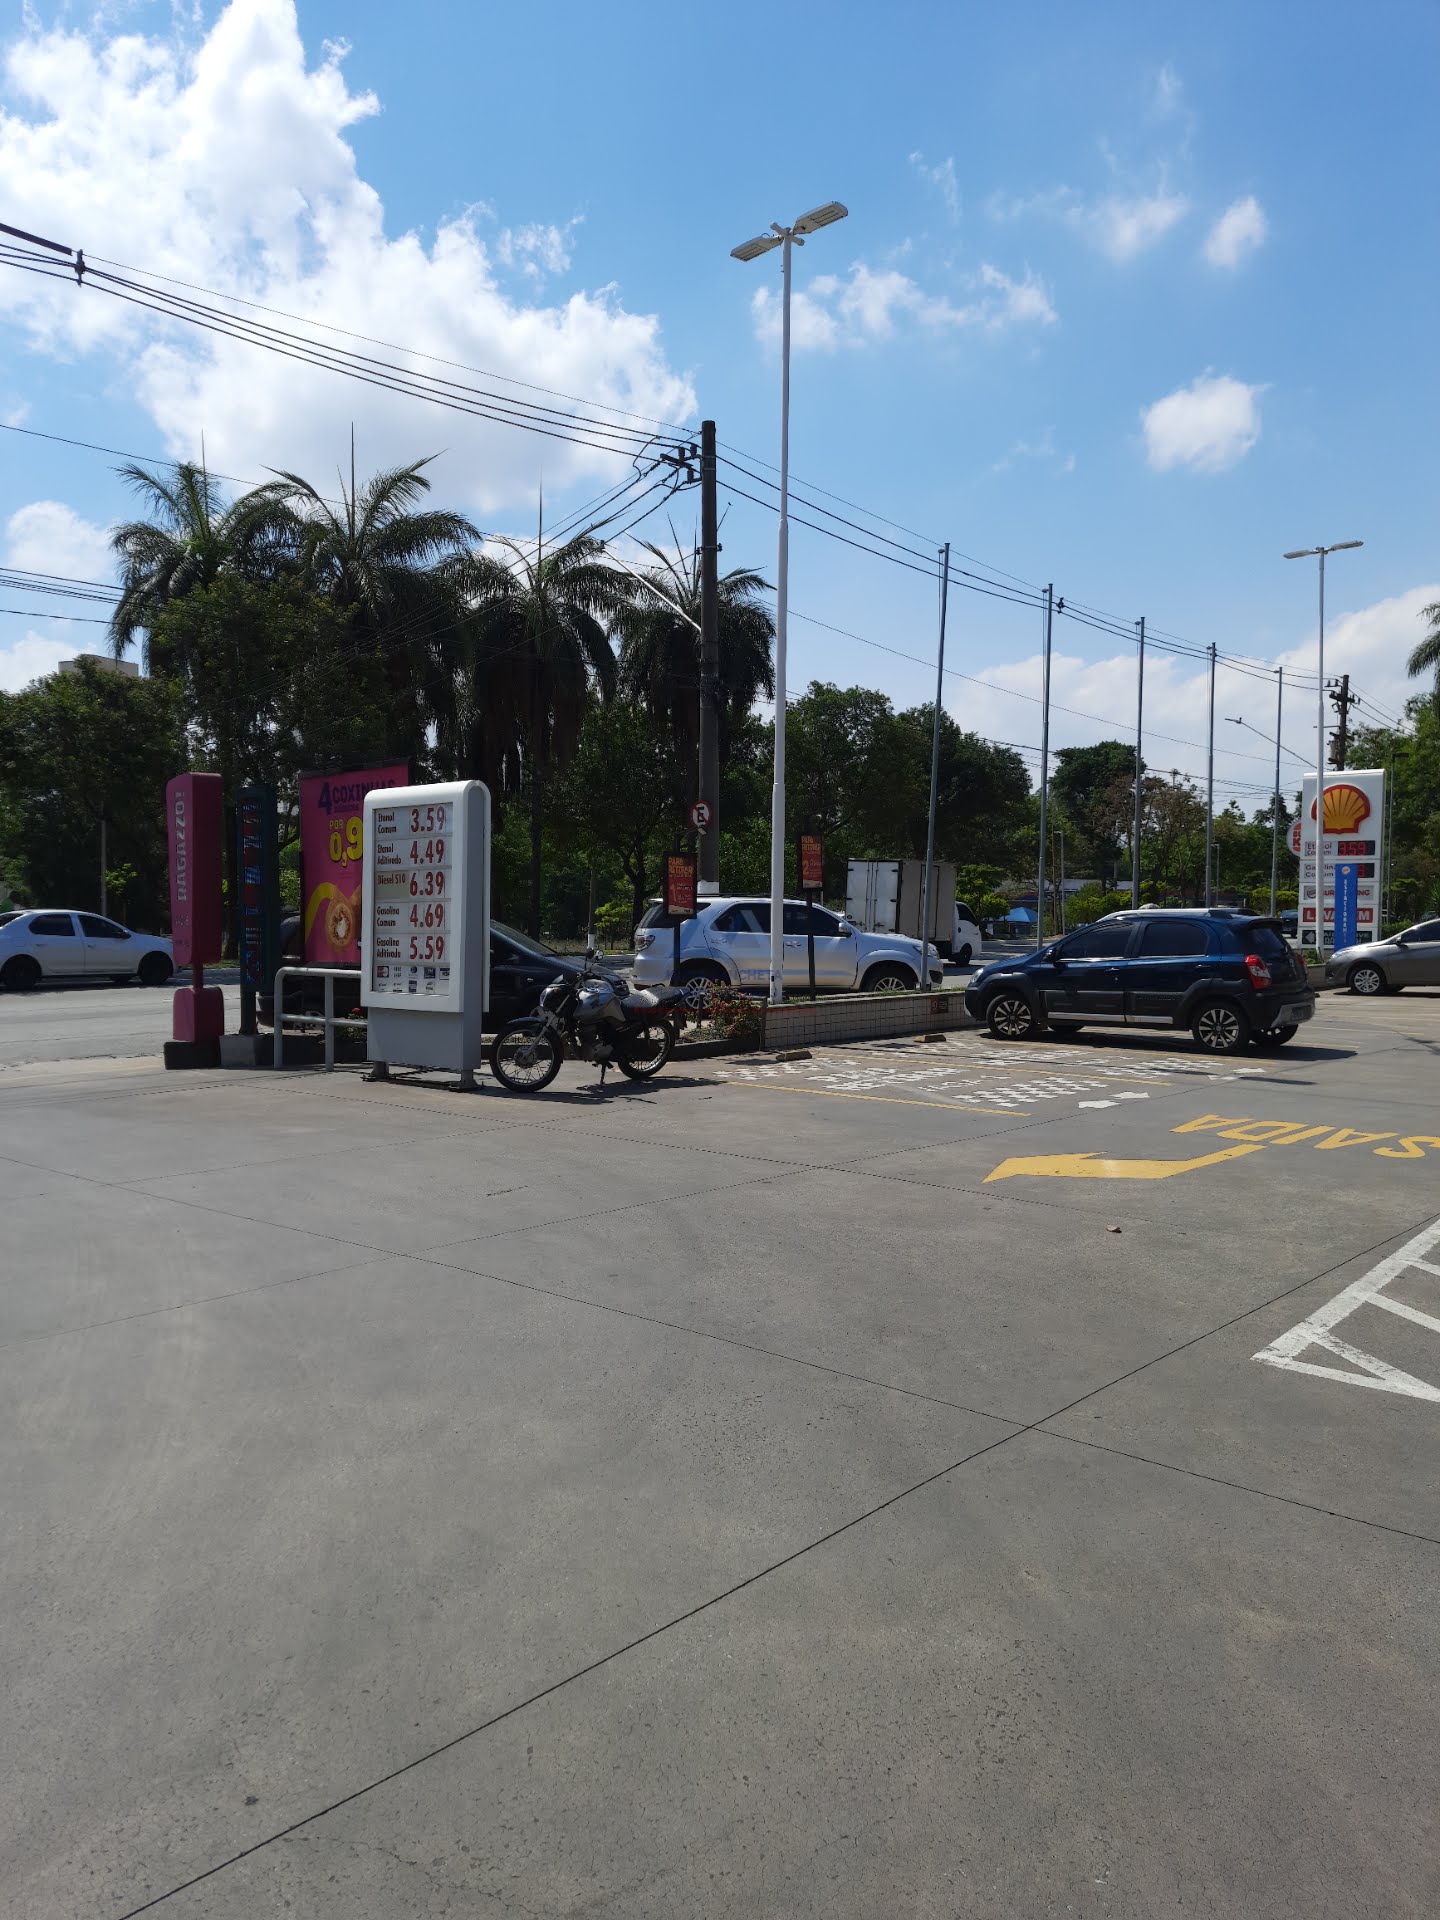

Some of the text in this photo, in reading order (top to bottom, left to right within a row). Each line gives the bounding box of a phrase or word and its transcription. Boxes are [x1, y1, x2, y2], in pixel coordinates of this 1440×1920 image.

[318, 782, 332, 815] 4
[329, 818, 345, 830] POR
[377, 824, 397, 834] Comum
[378, 805, 445, 833] Etanol 3.59
[377, 839, 445, 865] Etanol 4.49
[1307, 842, 1332, 850] Etol
[377, 873, 394, 884] Diesel
[410, 871, 445, 896] 6.39
[376, 903, 444, 928] Gasolina 4.69
[376, 917, 396, 927] Comum
[376, 935, 444, 960] Gasolina 5.59
[1169, 1114, 1440, 1158] SAIDA
